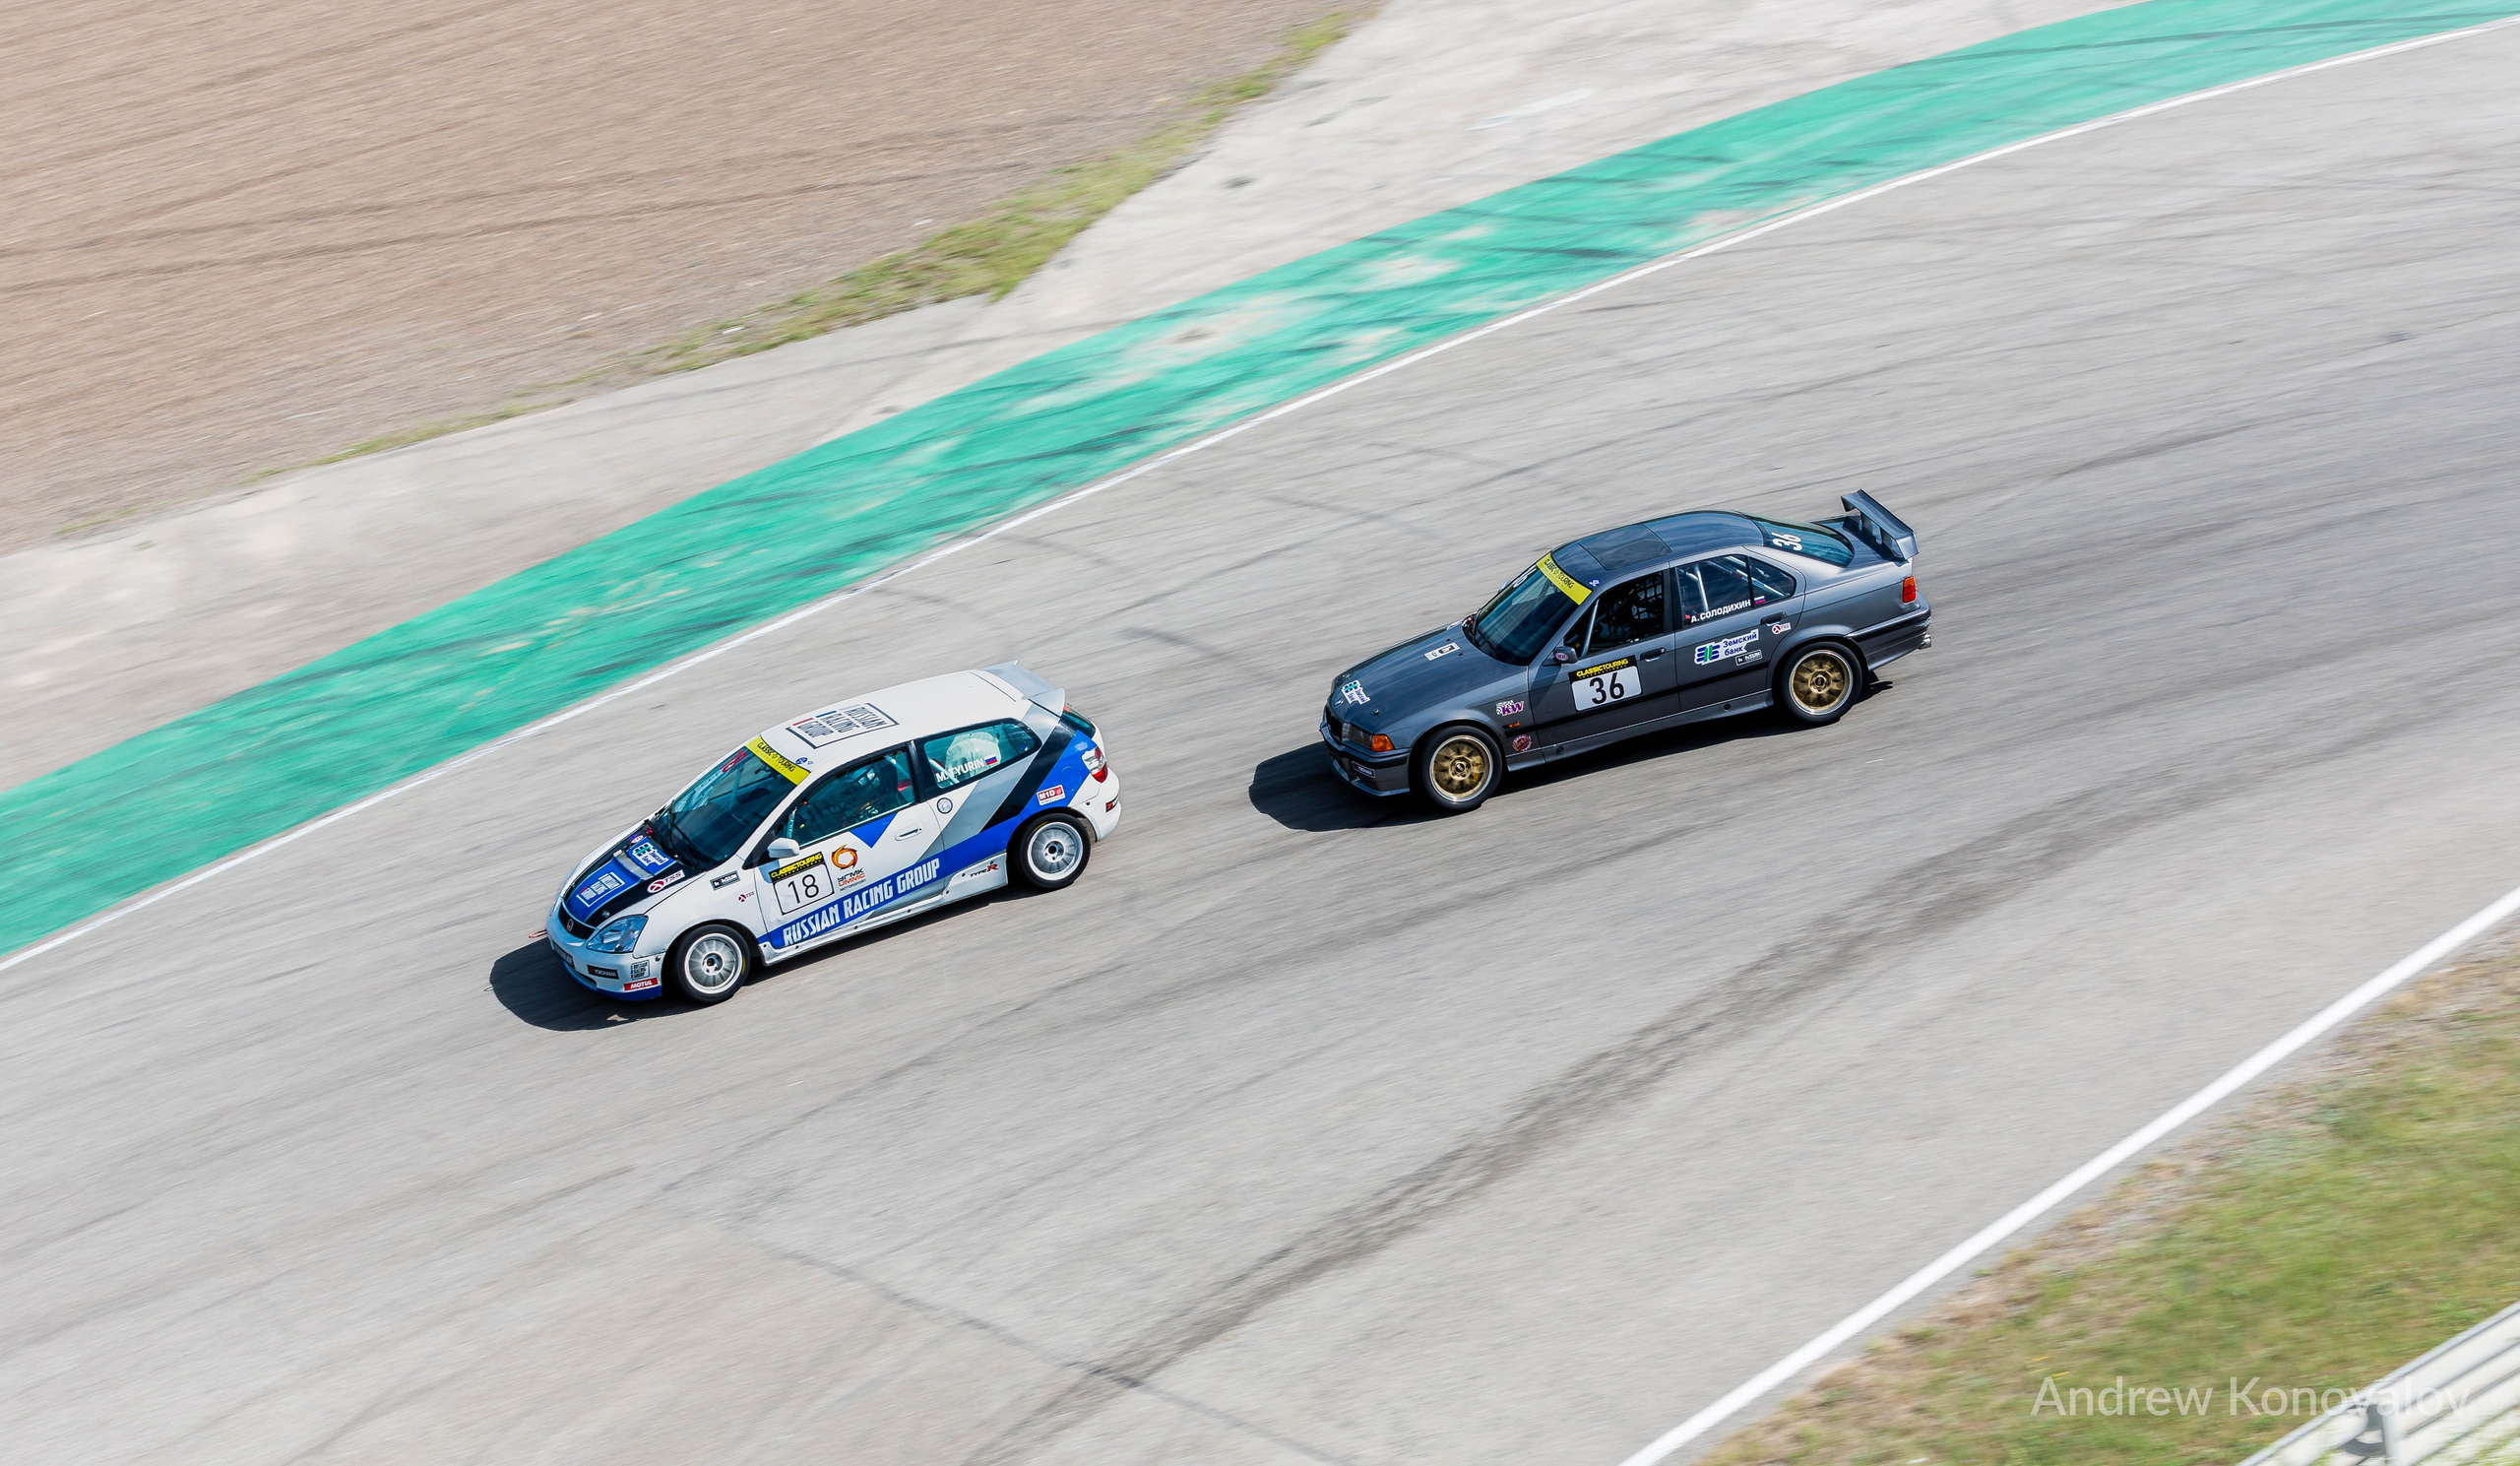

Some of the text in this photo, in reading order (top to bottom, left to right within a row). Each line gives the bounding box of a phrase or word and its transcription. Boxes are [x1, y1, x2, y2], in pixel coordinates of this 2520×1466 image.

[1771, 533, 1803, 551] 36
[1723, 630, 1757, 649] Земский
[1725, 645, 1743, 657] банк
[1576, 658, 1629, 677] CLASSICTOURING
[1589, 671, 1625, 705] 36
[1501, 700, 1525, 717] KW
[819, 713, 860, 733] RACING
[844, 706, 888, 730] RUSSIAN
[775, 753, 796, 773] TOURING
[837, 867, 864, 882] УГМК
[986, 862, 999, 873] R
[663, 870, 682, 884] TSS
[838, 872, 866, 887] UMMC
[788, 873, 820, 905] 18
[782, 858, 940, 946] RUSSIAN RACING GROUP
[630, 980, 654, 989] MOTUL
